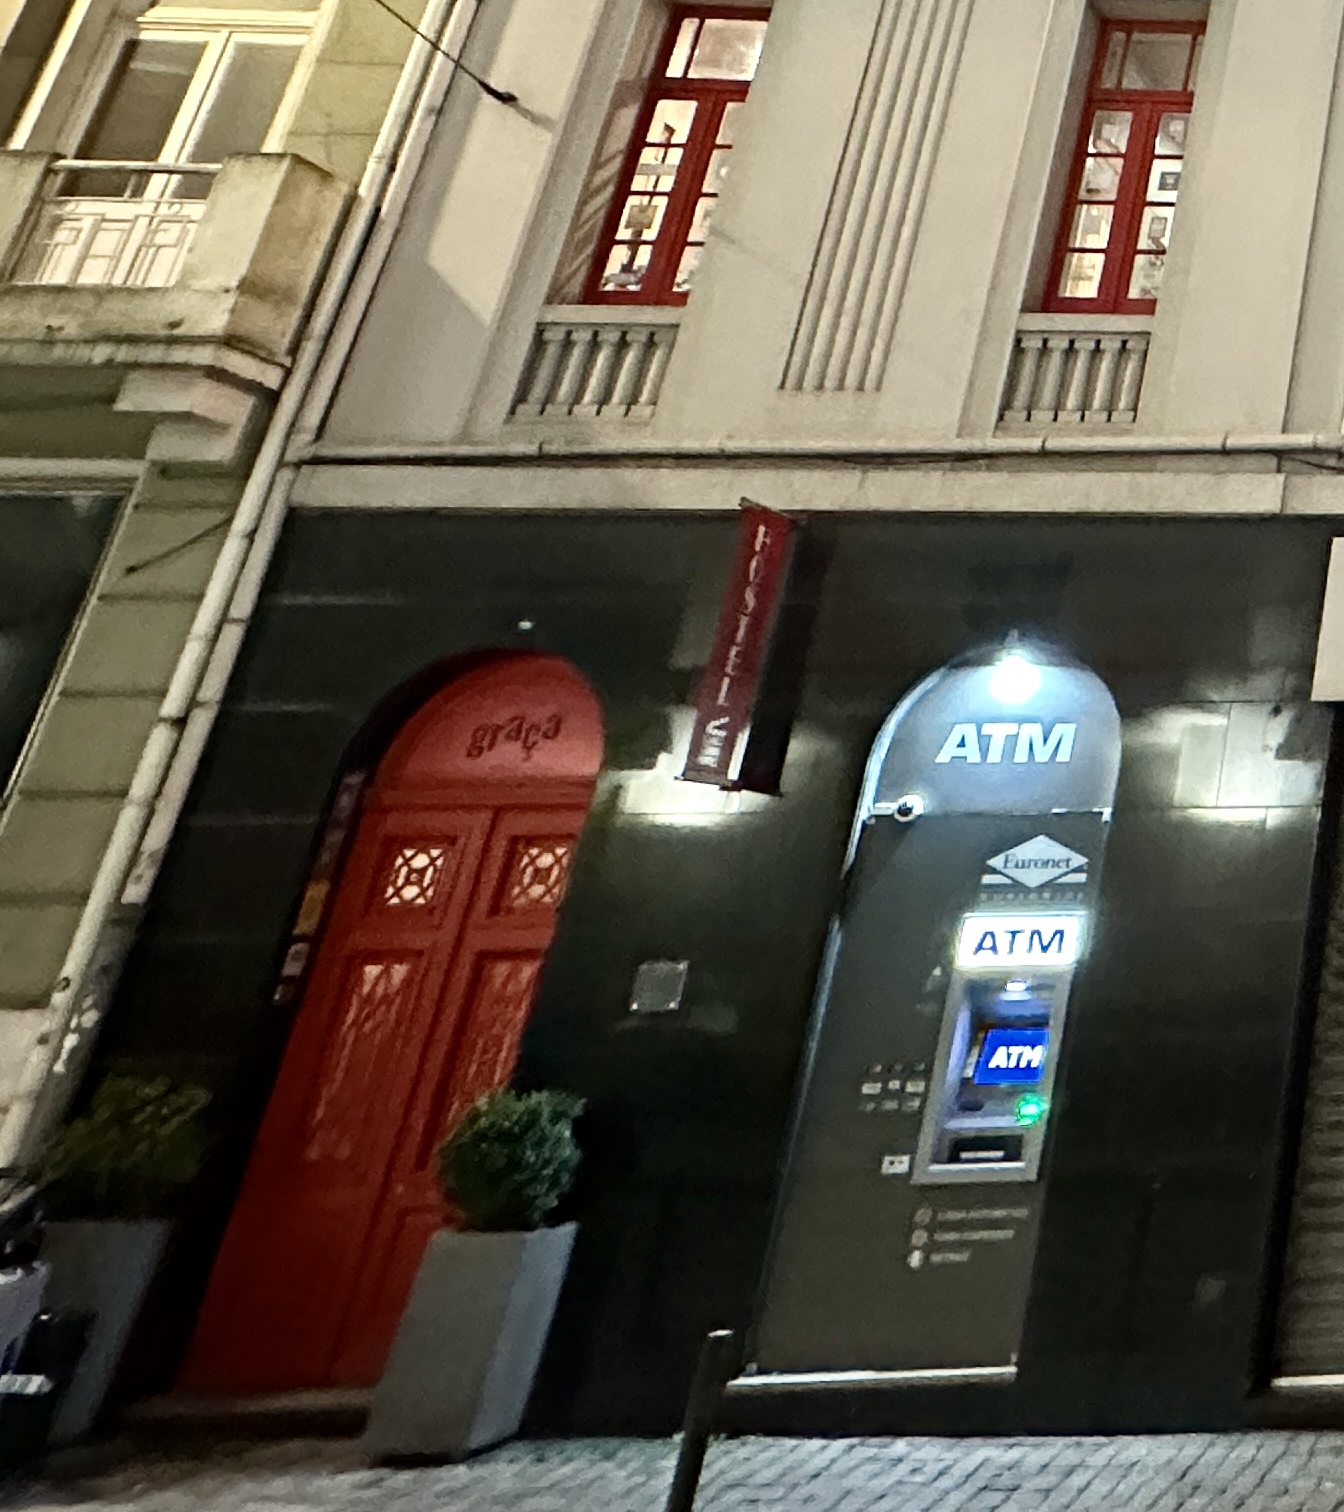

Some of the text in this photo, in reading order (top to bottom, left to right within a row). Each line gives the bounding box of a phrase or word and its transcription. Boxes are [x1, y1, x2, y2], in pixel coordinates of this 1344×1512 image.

[466, 712, 562, 763] graça
[934, 722, 1078, 764] ATM
[1002, 853, 1073, 870] Euronet
[973, 929, 1065, 956] ATM
[988, 1044, 1042, 1069] ATM
